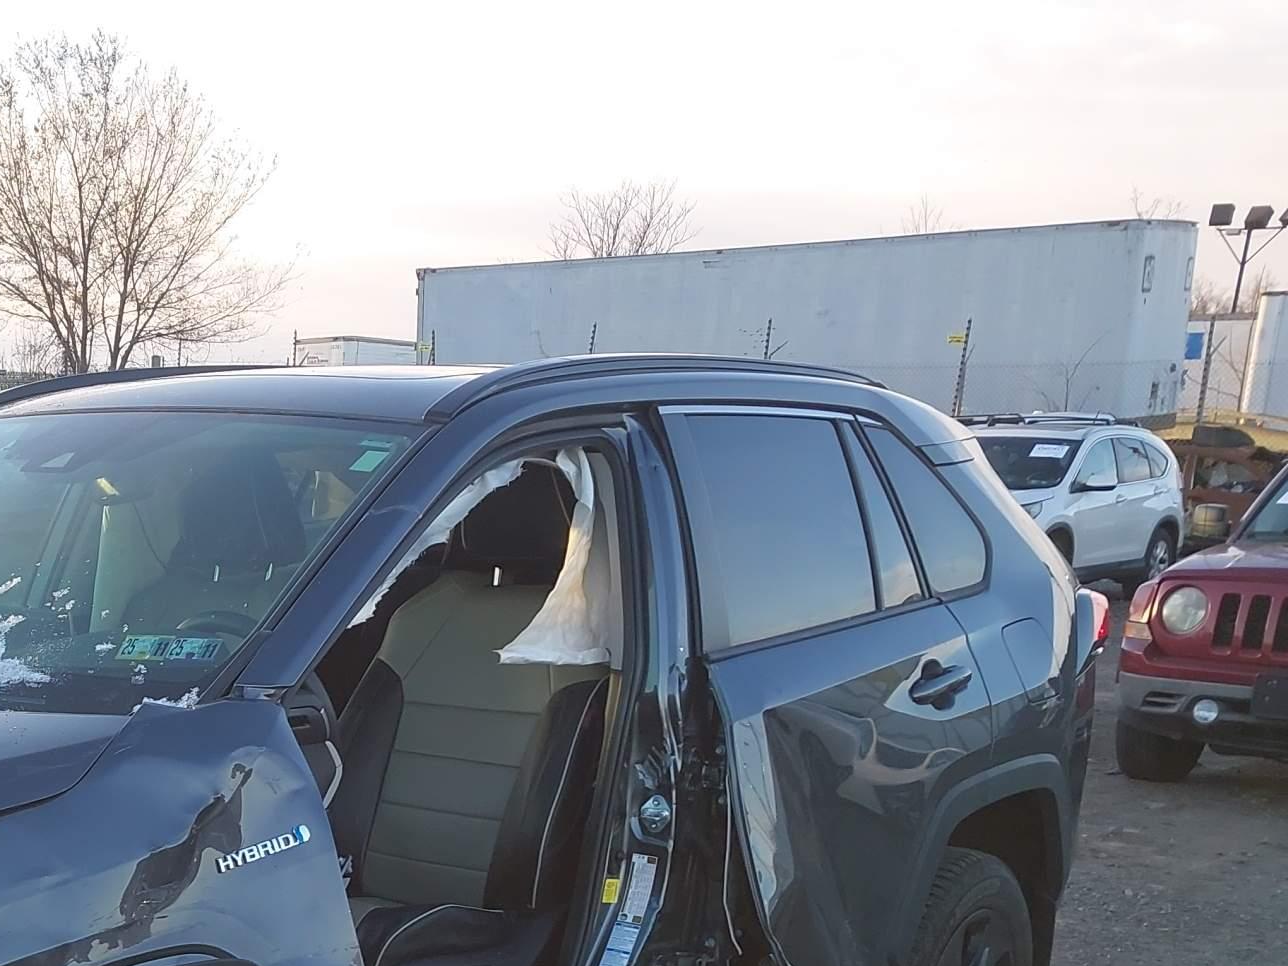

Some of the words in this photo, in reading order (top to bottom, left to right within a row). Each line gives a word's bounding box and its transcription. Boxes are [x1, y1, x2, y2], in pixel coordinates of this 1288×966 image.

[120, 638, 138, 655] 25
[170, 639, 187, 656] 25
[217, 833, 300, 873] HYBRID
